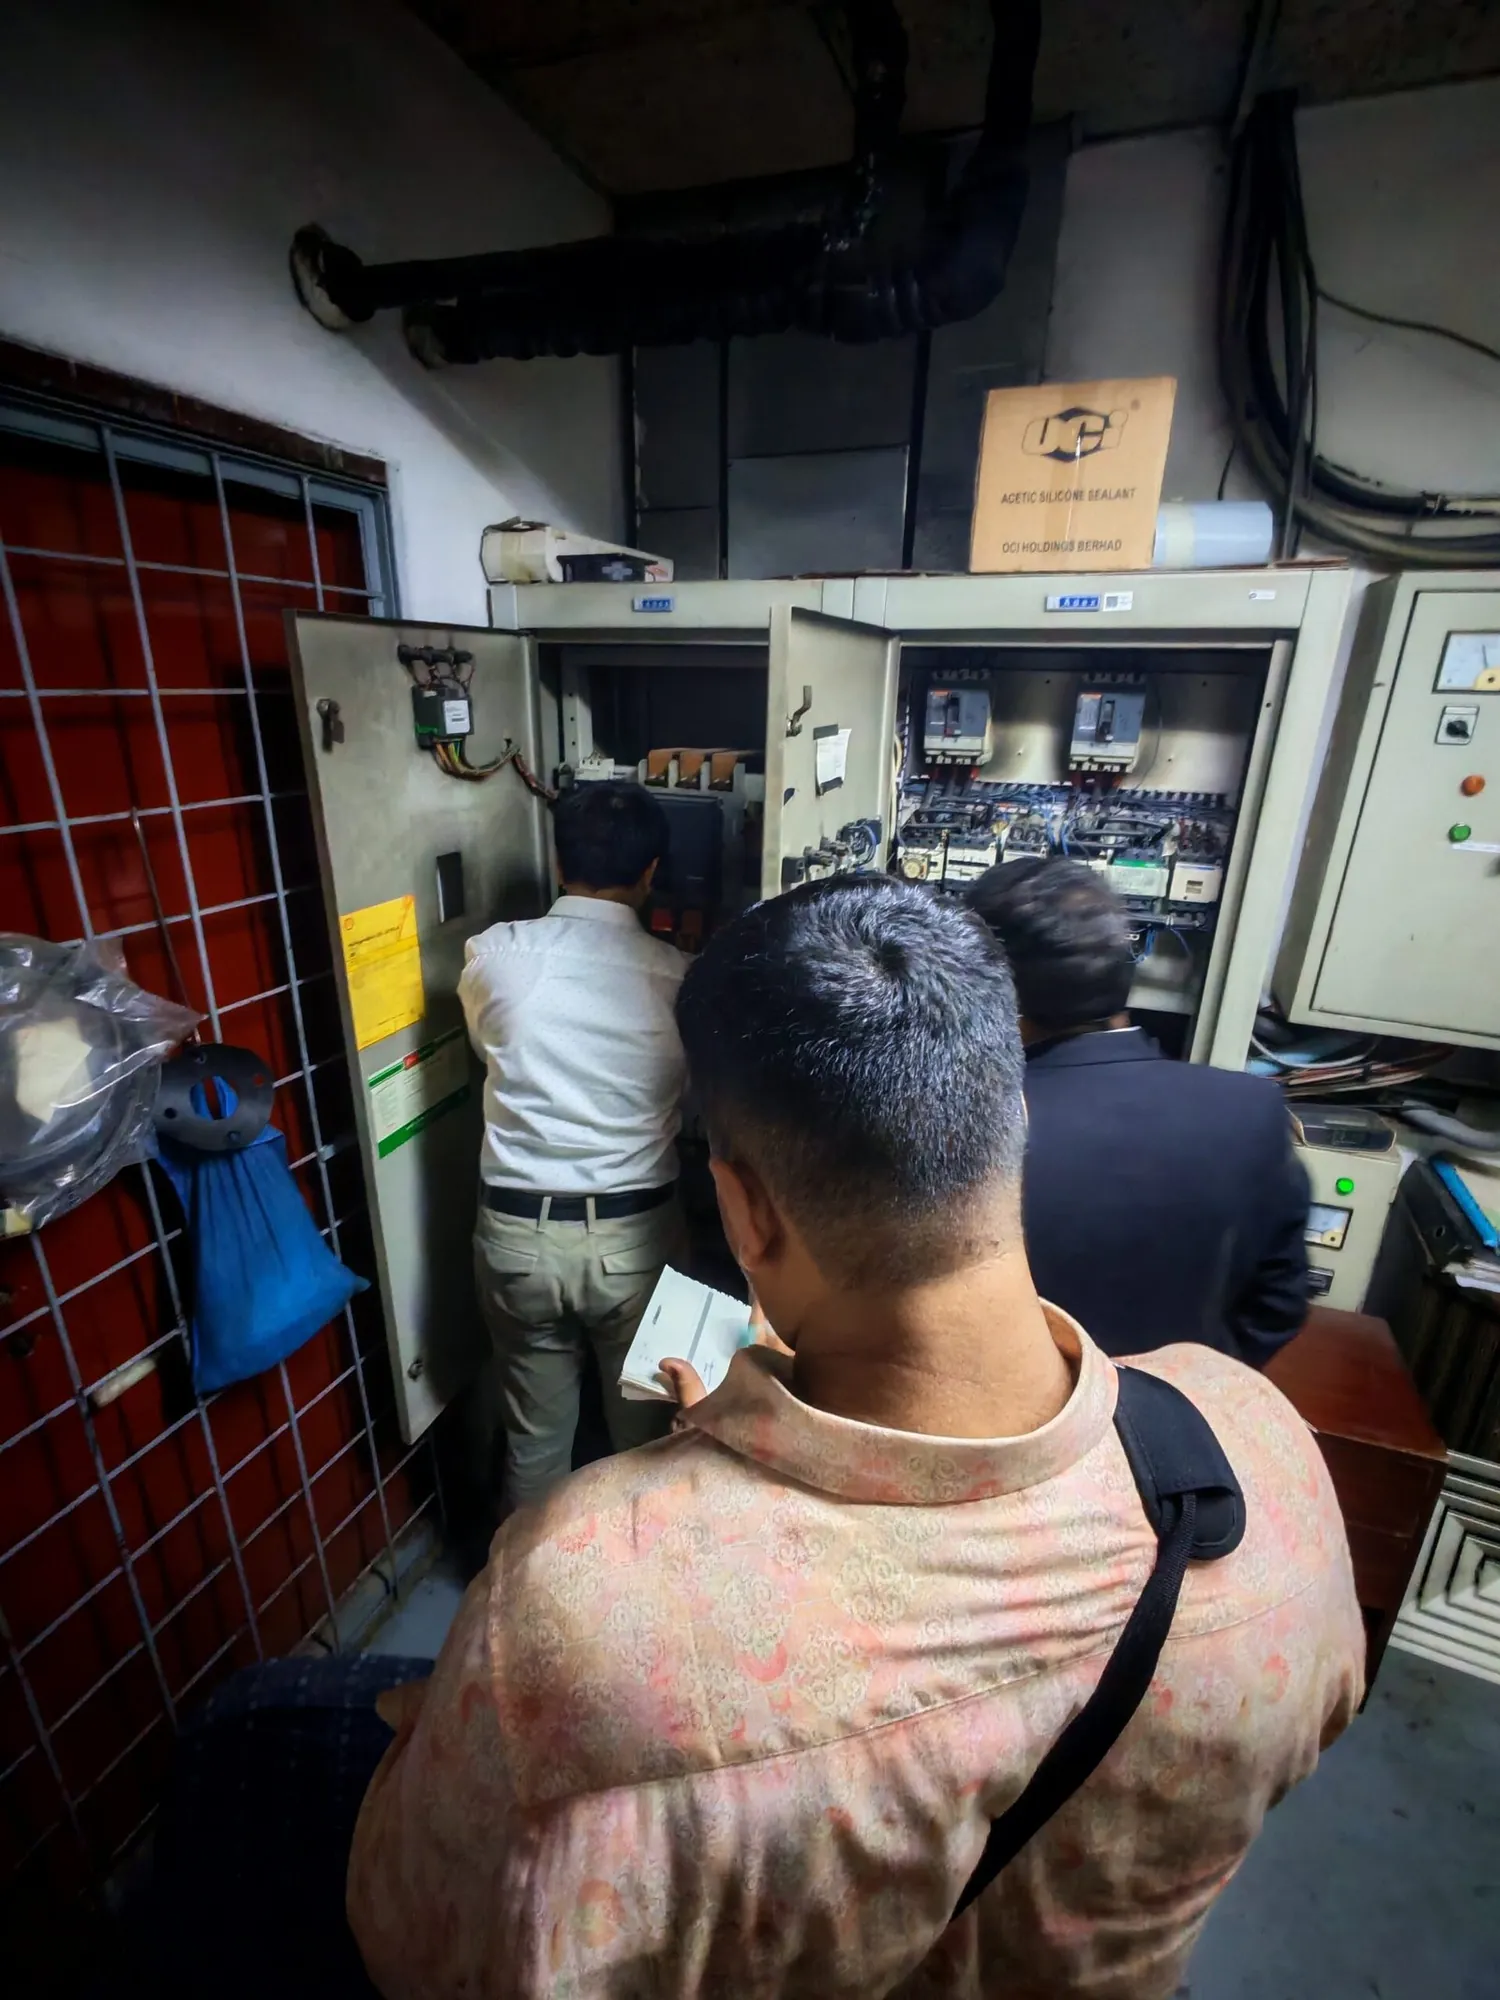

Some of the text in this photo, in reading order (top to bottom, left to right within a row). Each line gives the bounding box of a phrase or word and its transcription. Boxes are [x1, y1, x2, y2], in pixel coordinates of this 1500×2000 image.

[1001, 487, 1136, 505] ACETIC SILICONE SEALANT
[1002, 539, 1122, 554] OCI HOLDINGS BERHAD
